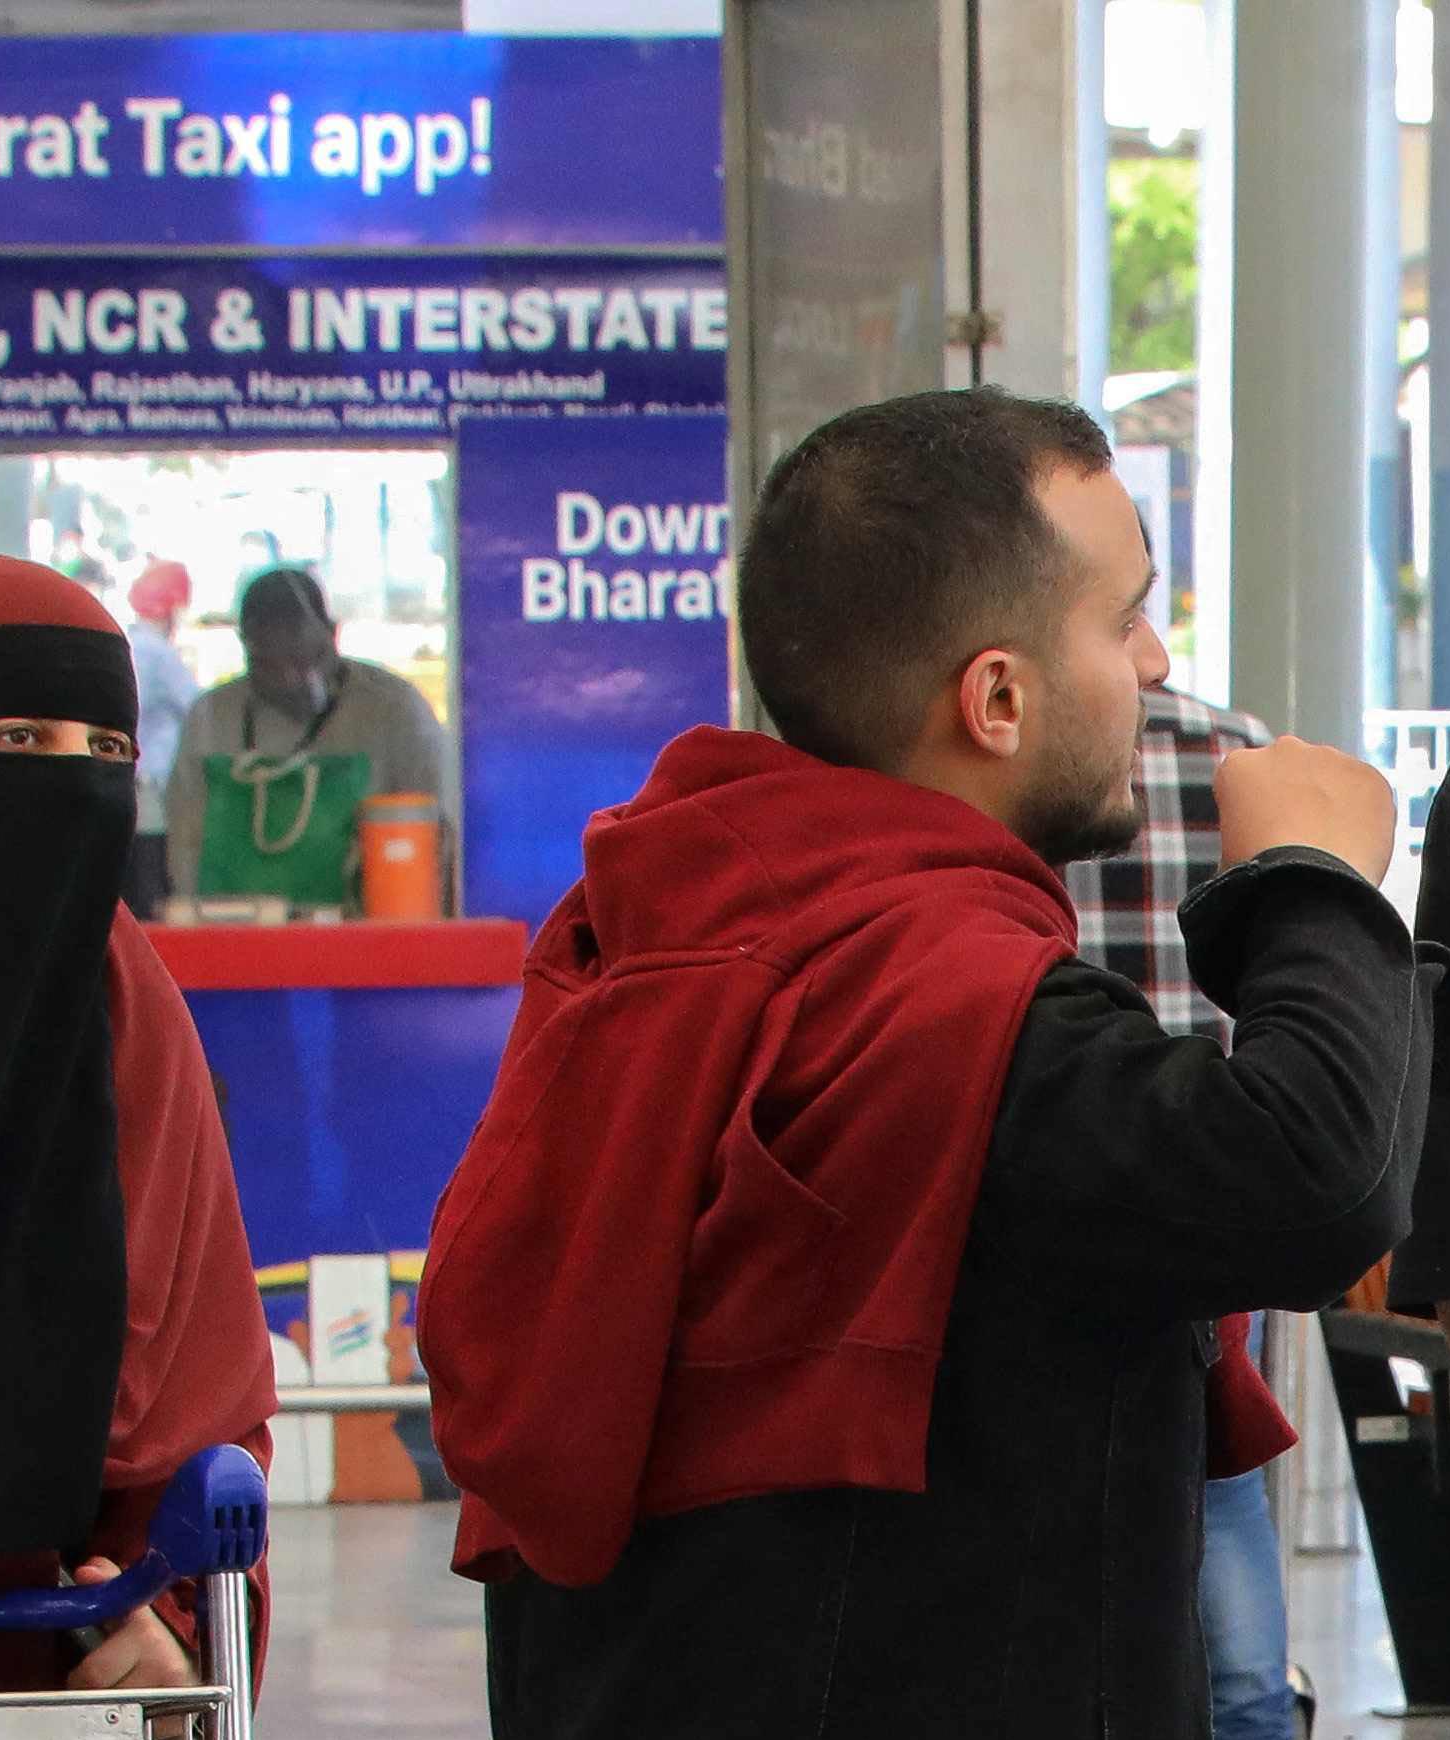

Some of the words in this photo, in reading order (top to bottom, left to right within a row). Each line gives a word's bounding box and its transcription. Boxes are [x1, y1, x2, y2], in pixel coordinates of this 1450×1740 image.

[124, 92, 293, 178] Taxi
[310, 97, 492, 196] app!
[33, 289, 190, 354] NCR
[209, 288, 266, 353] &
[288, 287, 729, 353] INTERSTATE
